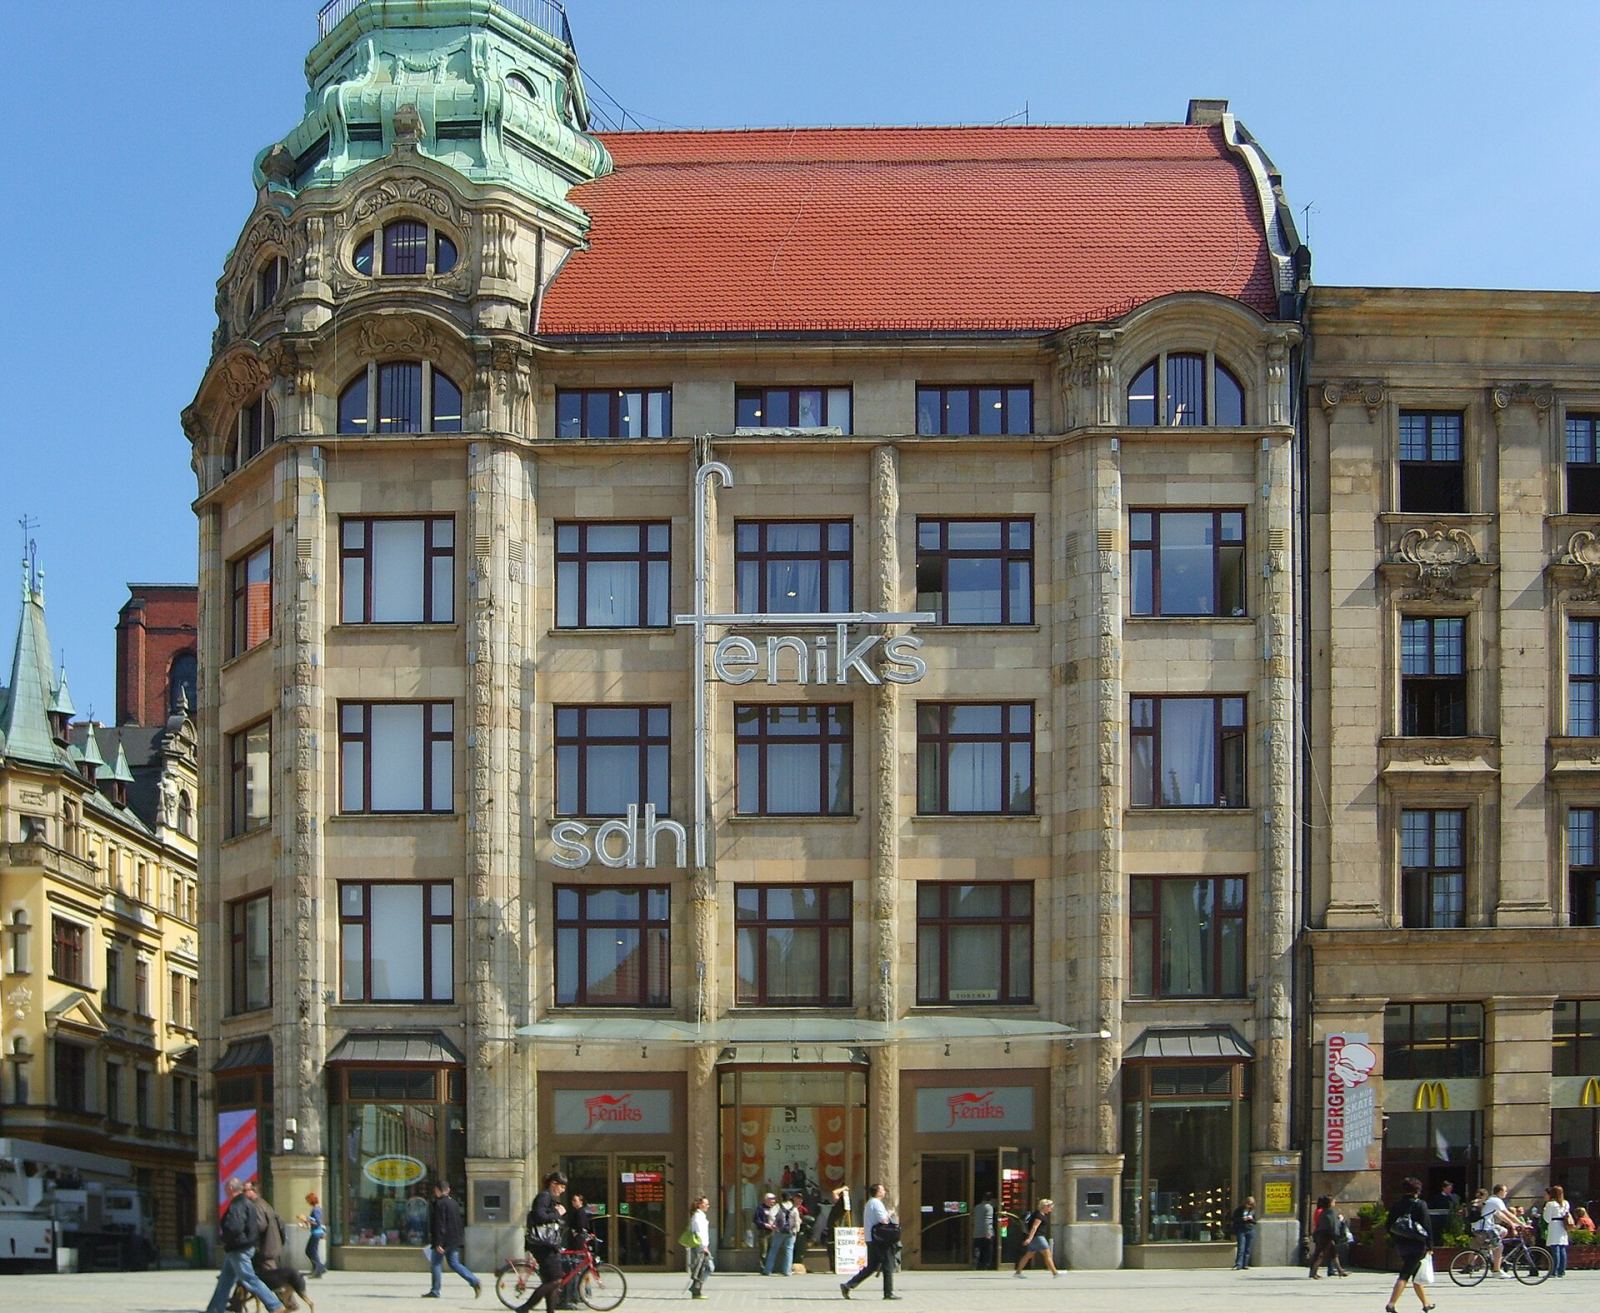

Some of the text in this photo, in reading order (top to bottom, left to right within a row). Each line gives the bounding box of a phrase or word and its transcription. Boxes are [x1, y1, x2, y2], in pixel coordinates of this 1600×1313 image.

[584, 1094, 643, 1129] Feniks
[946, 1091, 1006, 1128] Feniks
[1345, 1096, 1373, 1114] SKATE
[775, 1138, 782, 1151] 3
